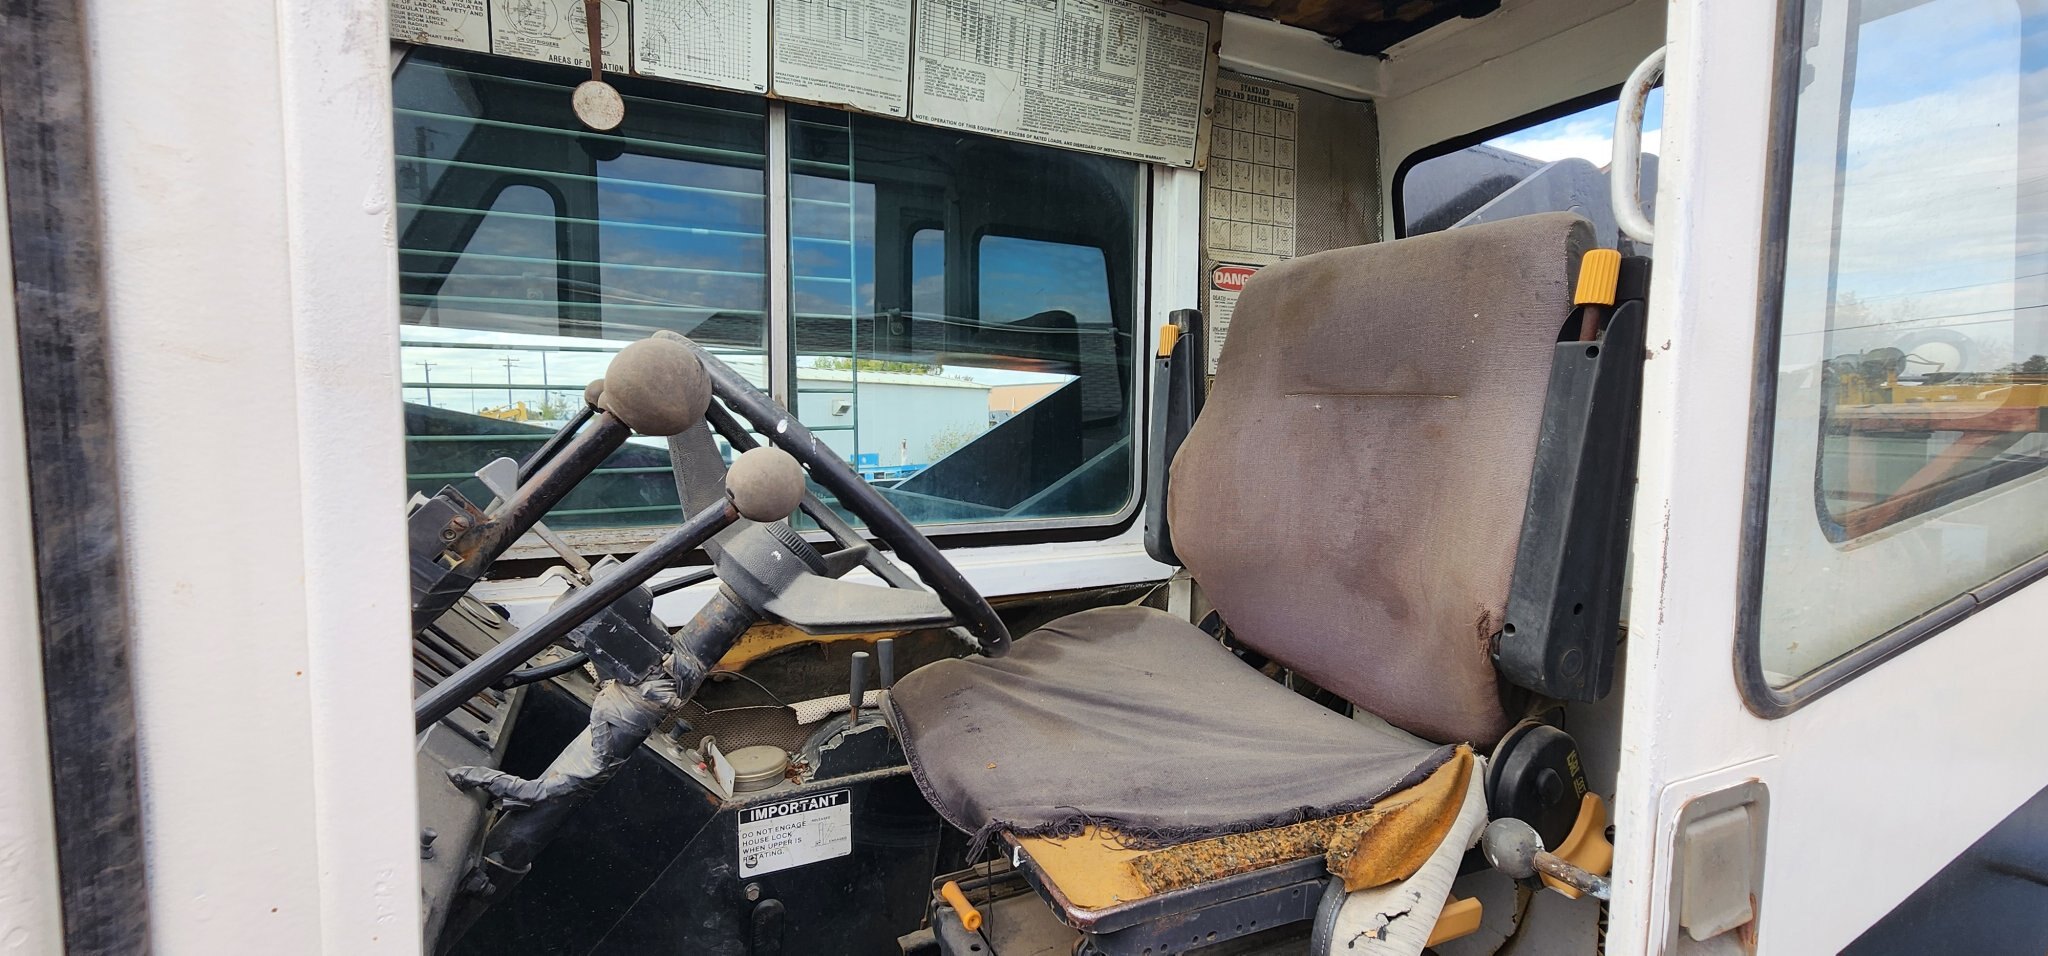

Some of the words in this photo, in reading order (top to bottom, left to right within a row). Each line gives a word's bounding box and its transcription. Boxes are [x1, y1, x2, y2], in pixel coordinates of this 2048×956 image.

[442, 5, 466, 14] SAFETY
[452, 1, 483, 11] VIOLATES
[548, 54, 572, 65] AREAS
[574, 58, 583, 66] OF
[585, 61, 624, 73] ORATION
[1241, 84, 1270, 96] STANDARD
[1216, 87, 1231, 97] RANE
[1233, 92, 1245, 100] AND
[1247, 94, 1271, 105] DERRICK
[1272, 99, 1294, 110] SIGNALS
[930, 116, 957, 126] OPERATION
[977, 125, 1003, 134] EQUIPMENT
[1008, 131, 1026, 139] EXCESS
[1103, 147, 1132, 156] INSTRUCTIONS
[1145, 153, 1167, 161] WARRANTY
[1215, 271, 1250, 286] DANG
[750, 794, 839, 822] IMPORTANT
[756, 828, 773, 836] NOT
[775, 821, 807, 832] ENGAGE
[742, 836, 769, 847] HOUSE
[772, 831, 792, 841] LOCK
[743, 844, 766, 855] WHEN
[768, 839, 792, 850] UPPER
